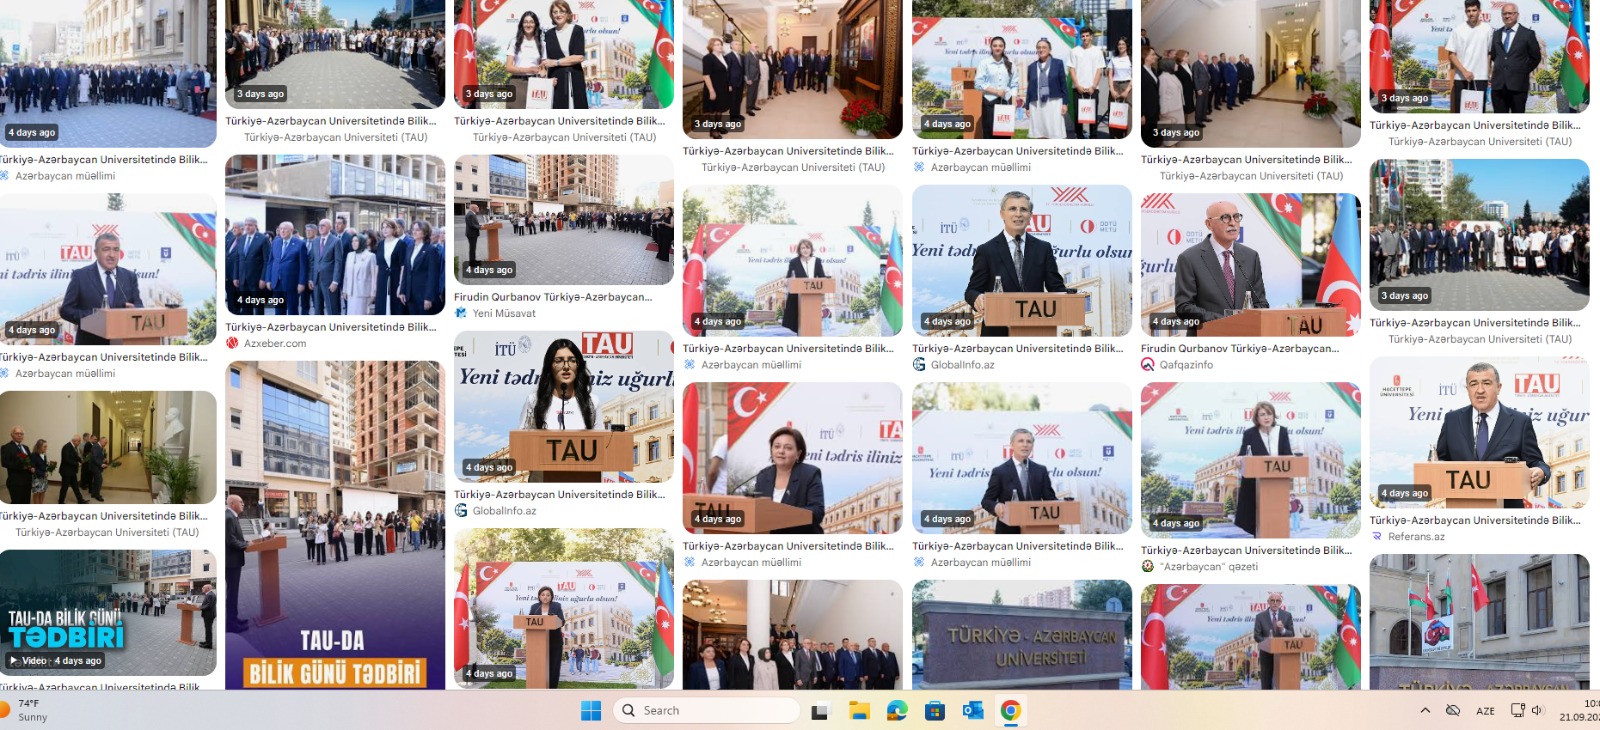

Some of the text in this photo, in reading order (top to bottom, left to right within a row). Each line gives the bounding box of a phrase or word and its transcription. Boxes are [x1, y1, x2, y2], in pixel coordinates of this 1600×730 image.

[237, 89, 285, 100] 3 days ago
[1369, 120, 1471, 132] Türkiyə-Azərbaycan
[1473, 120, 1550, 130] Universitetində
[243, 132, 428, 144] Türkiyə-Azərbaycan Universiteti (TAU)
[472, 132, 657, 144] Türkiyə-Azərbaycan Universiteti (TAU)
[1153, 128, 1200, 138] 3 days ago
[1388, 136, 1573, 149] Türkiyə-Azərbaycan Universiteti (TAU)
[682, 145, 784, 158] Türkiyə-Azərbaycan
[786, 146, 863, 156] Universitetində
[701, 162, 886, 174] Türkiyə-Azərbaycan Universiteti (TAU)
[930, 162, 1032, 174] Azərbaycan müəllimi
[15, 170, 116, 183] Azərbaycan müəllimi
[1159, 170, 1344, 183] Türkiyə-Azərbaycan Universiteti (TAU)
[940, 222, 957, 234] İTÜ
[1026, 215, 1050, 232] AU
[61, 246, 93, 260] TAU
[912, 243, 945, 257] Yeni
[1052, 245, 1091, 258] ğurlu
[11, 269, 48, 280] tədris
[804, 281, 824, 290] TAU
[454, 291, 490, 302] Firudin
[491, 292, 542, 302] Qurbanov
[472, 308, 537, 318] Yeni Müsavat
[1015, 300, 1057, 318] TAU
[132, 314, 165, 332] TAU
[224, 322, 327, 334] Türkiyə-Azərbaycan
[328, 322, 405, 332] Universitetində
[1287, 316, 1323, 335] TAU
[8, 325, 56, 336] 4 days ago
[243, 338, 307, 348] Azxeber.com
[582, 332, 633, 354] TAU
[1388, 333, 1573, 346] Türkiyə-Azərbaycan Universiteti (TAU)
[495, 341, 516, 357] İTÜ
[701, 359, 802, 372] Azərbaycan müəllimi
[930, 359, 995, 370] GlobalInfo.az
[1159, 359, 1214, 372] Qafqazinfo
[15, 368, 116, 380] Azərbaycan müəllimi
[460, 368, 674, 392] Yeni uğurl
[1438, 383, 1457, 396] İTÜ
[1515, 374, 1560, 393] TAU
[1409, 406, 1443, 421] Yeni
[1184, 425, 1325, 436] Yeni tədris olsun!
[546, 439, 598, 462] TAU
[825, 449, 863, 463] tədris
[866, 450, 903, 464] iliniz
[929, 466, 1102, 478] Yeni tədris olsun!
[1264, 460, 1291, 473] TAU
[1446, 470, 1491, 489] TAU
[472, 505, 537, 516] GlobalInfo.az
[1030, 506, 1060, 520] TAU
[1369, 515, 1471, 528] Türkiyə-Azərbaycan
[1473, 515, 1550, 525] Universitetində
[15, 527, 200, 539] Türkiyə-Azərbaycan Universiteti (TAU)
[1388, 531, 1446, 541] Referans.az
[911, 541, 1014, 553] Türkiyə-Azərbaycan
[1015, 540, 1092, 551] Universitetində
[1140, 545, 1243, 558] Türkiyə-Azərbaycan
[1244, 545, 1321, 555] Universitetində
[701, 557, 802, 569] Azərbaycan müəllimi
[930, 557, 1032, 569] Azərbaycan müəllimi
[1228, 561, 1259, 574] qəzeti
[558, 582, 576, 590] TAU
[526, 617, 544, 626] TAU
[948, 625, 1021, 644] TÜRKİYƏ
[1033, 629, 1117, 645] AZƏRBAYCAN
[1284, 640, 1304, 649] TAU
[22, 656, 47, 665] Video
[62, 656, 84, 667] days
[85, 658, 102, 667] ago
[996, 649, 1088, 668] UNİVERSİTETİ
[18, 699, 40, 708] 74°F
[644, 705, 680, 716] Search
[1476, 706, 1495, 716] AZE
[18, 713, 48, 724] Sunny
